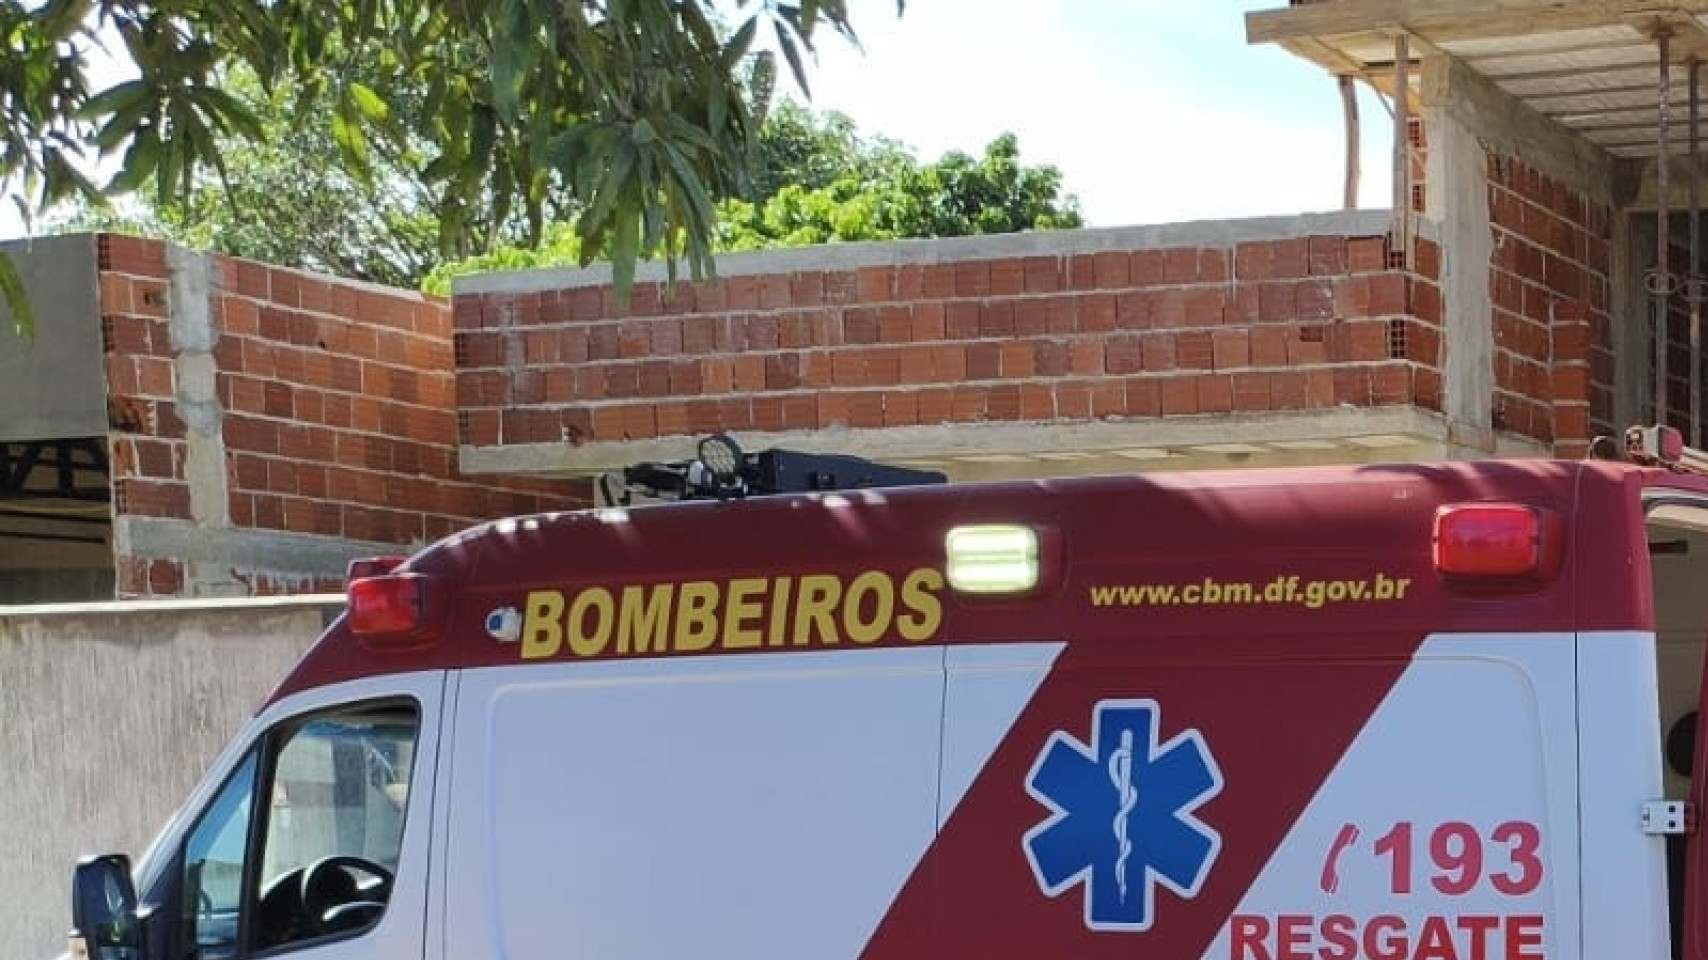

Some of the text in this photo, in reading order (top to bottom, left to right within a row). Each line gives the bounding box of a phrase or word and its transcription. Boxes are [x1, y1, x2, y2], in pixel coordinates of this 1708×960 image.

[520, 567, 944, 659] BOMBEIROS
[1089, 572, 1411, 608] www.cbm.df.gov.br
[1373, 821, 1544, 895] 193
